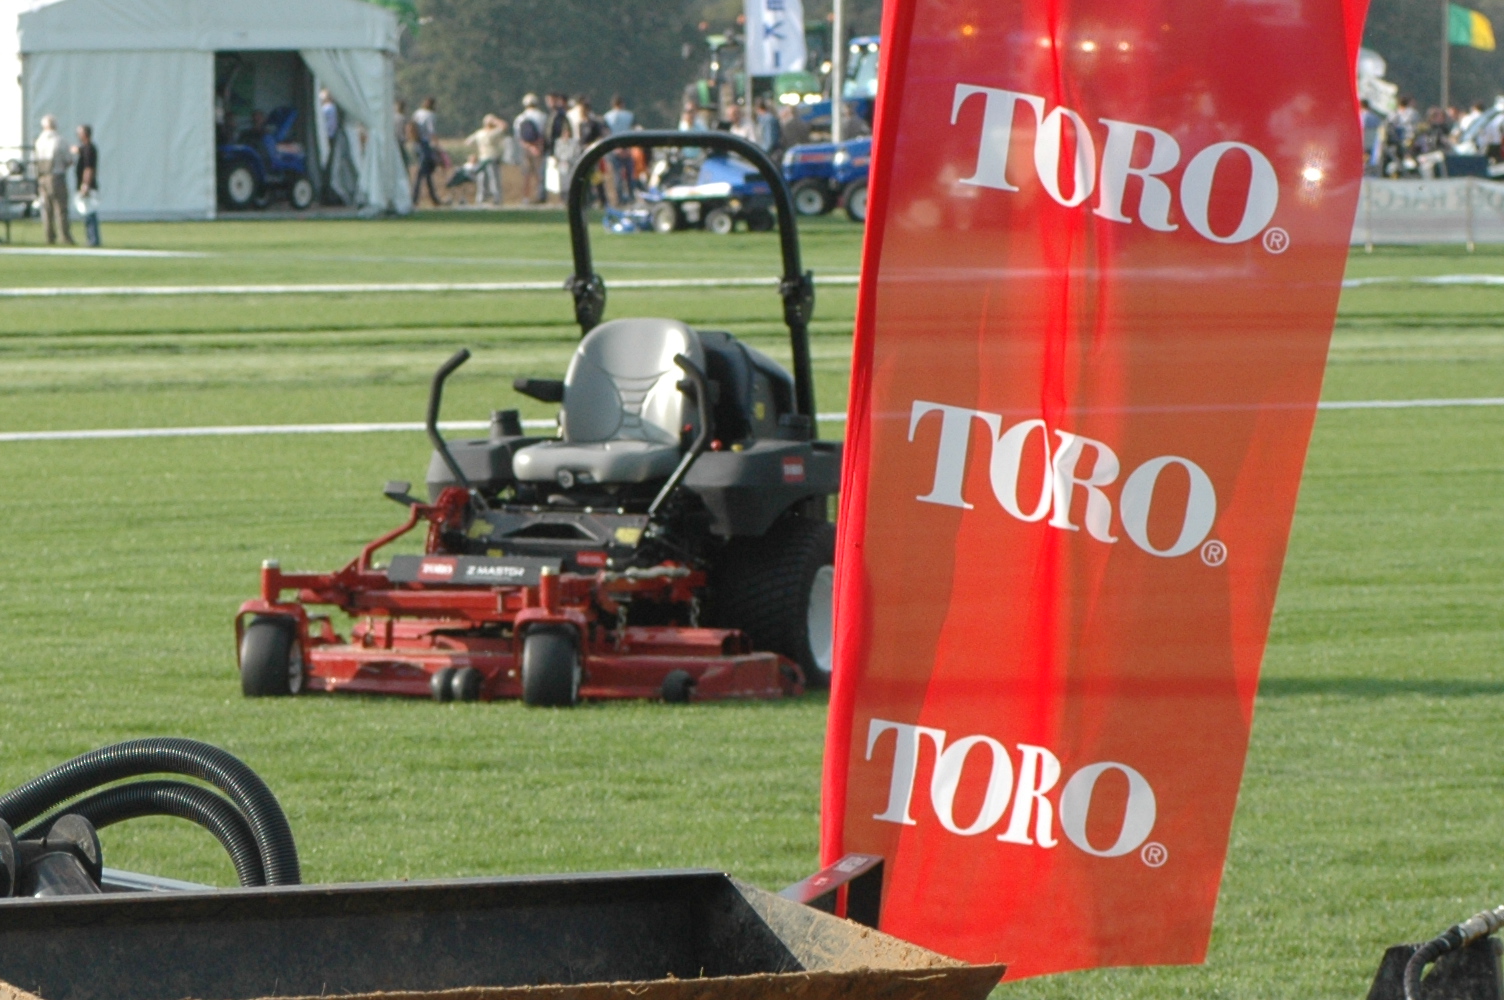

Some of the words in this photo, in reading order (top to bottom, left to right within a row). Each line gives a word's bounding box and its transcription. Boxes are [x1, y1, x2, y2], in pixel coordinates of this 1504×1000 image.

[950, 82, 1280, 244] TORO
[907, 399, 1217, 558] TORO
[865, 717, 1157, 858] TORO
